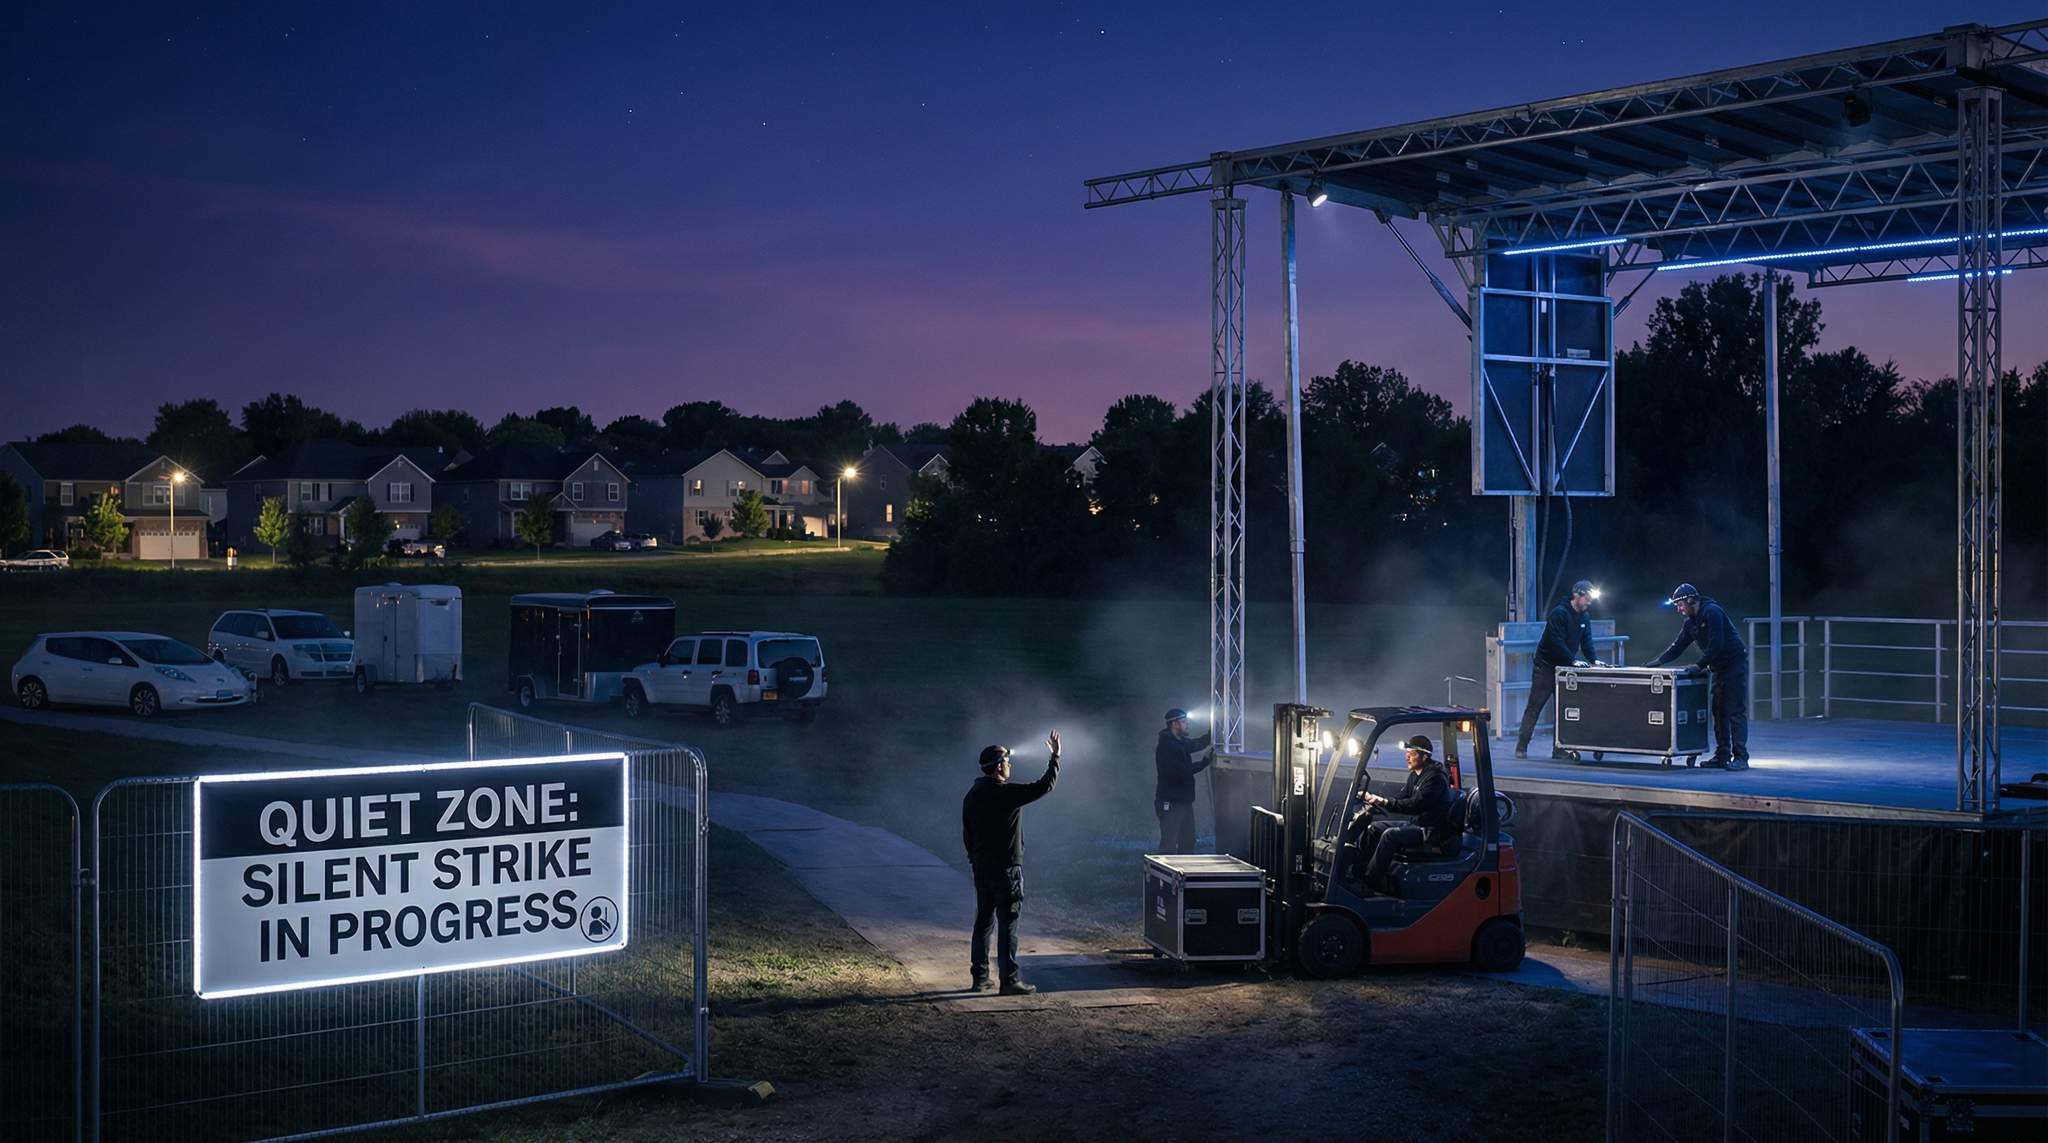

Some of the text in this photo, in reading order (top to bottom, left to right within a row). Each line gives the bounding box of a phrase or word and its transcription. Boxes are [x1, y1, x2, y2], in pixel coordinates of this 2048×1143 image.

[259, 782, 577, 847] QUIET ZONE:
[242, 837, 592, 907] SILENT STRIKE
[260, 889, 577, 962] IN PROGRESS
